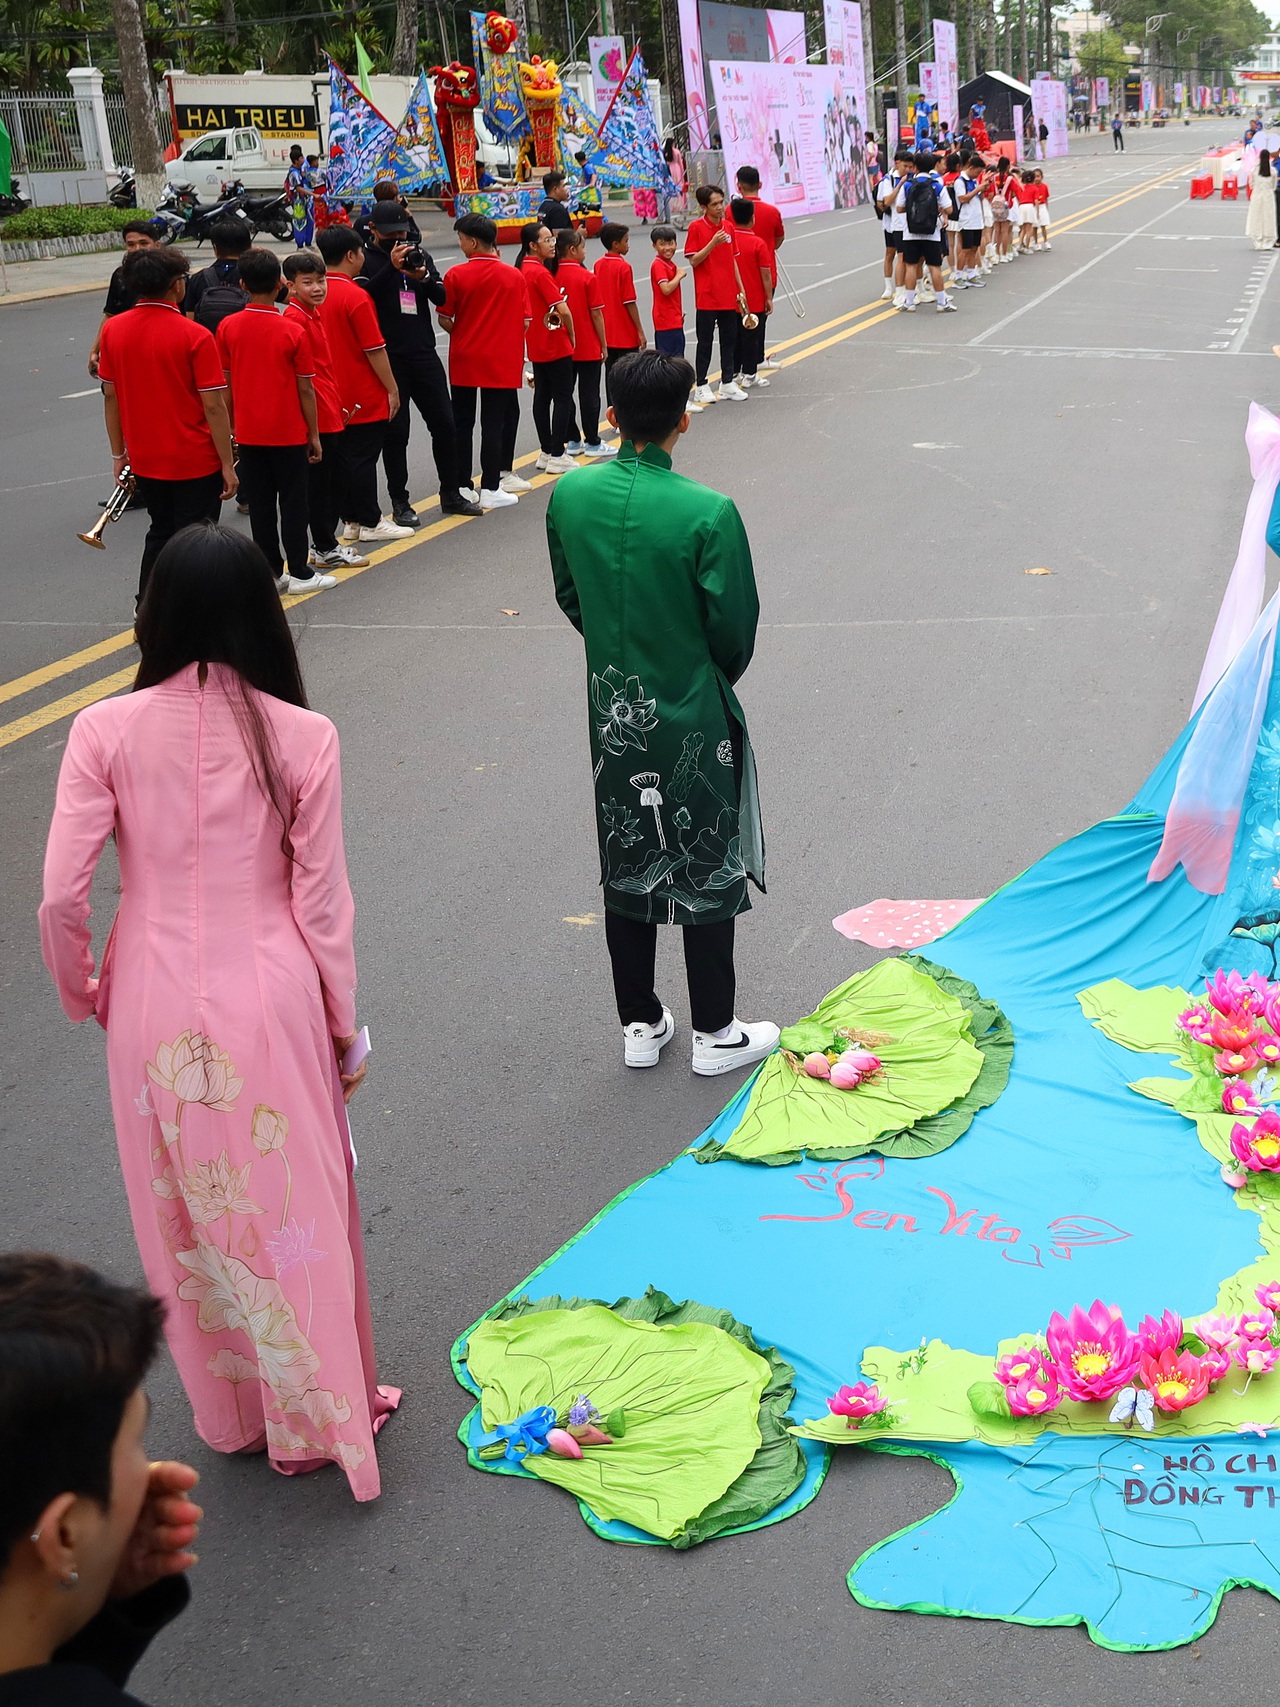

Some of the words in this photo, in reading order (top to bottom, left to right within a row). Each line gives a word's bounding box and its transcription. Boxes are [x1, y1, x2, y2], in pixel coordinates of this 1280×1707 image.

[186, 108, 227, 127] HAI
[234, 108, 305, 128] TRIEU
[758, 1172, 922, 1234] Sen
[925, 1186, 1021, 1243] Vita
[1115, 1471, 1225, 1506] ĐỒNG
